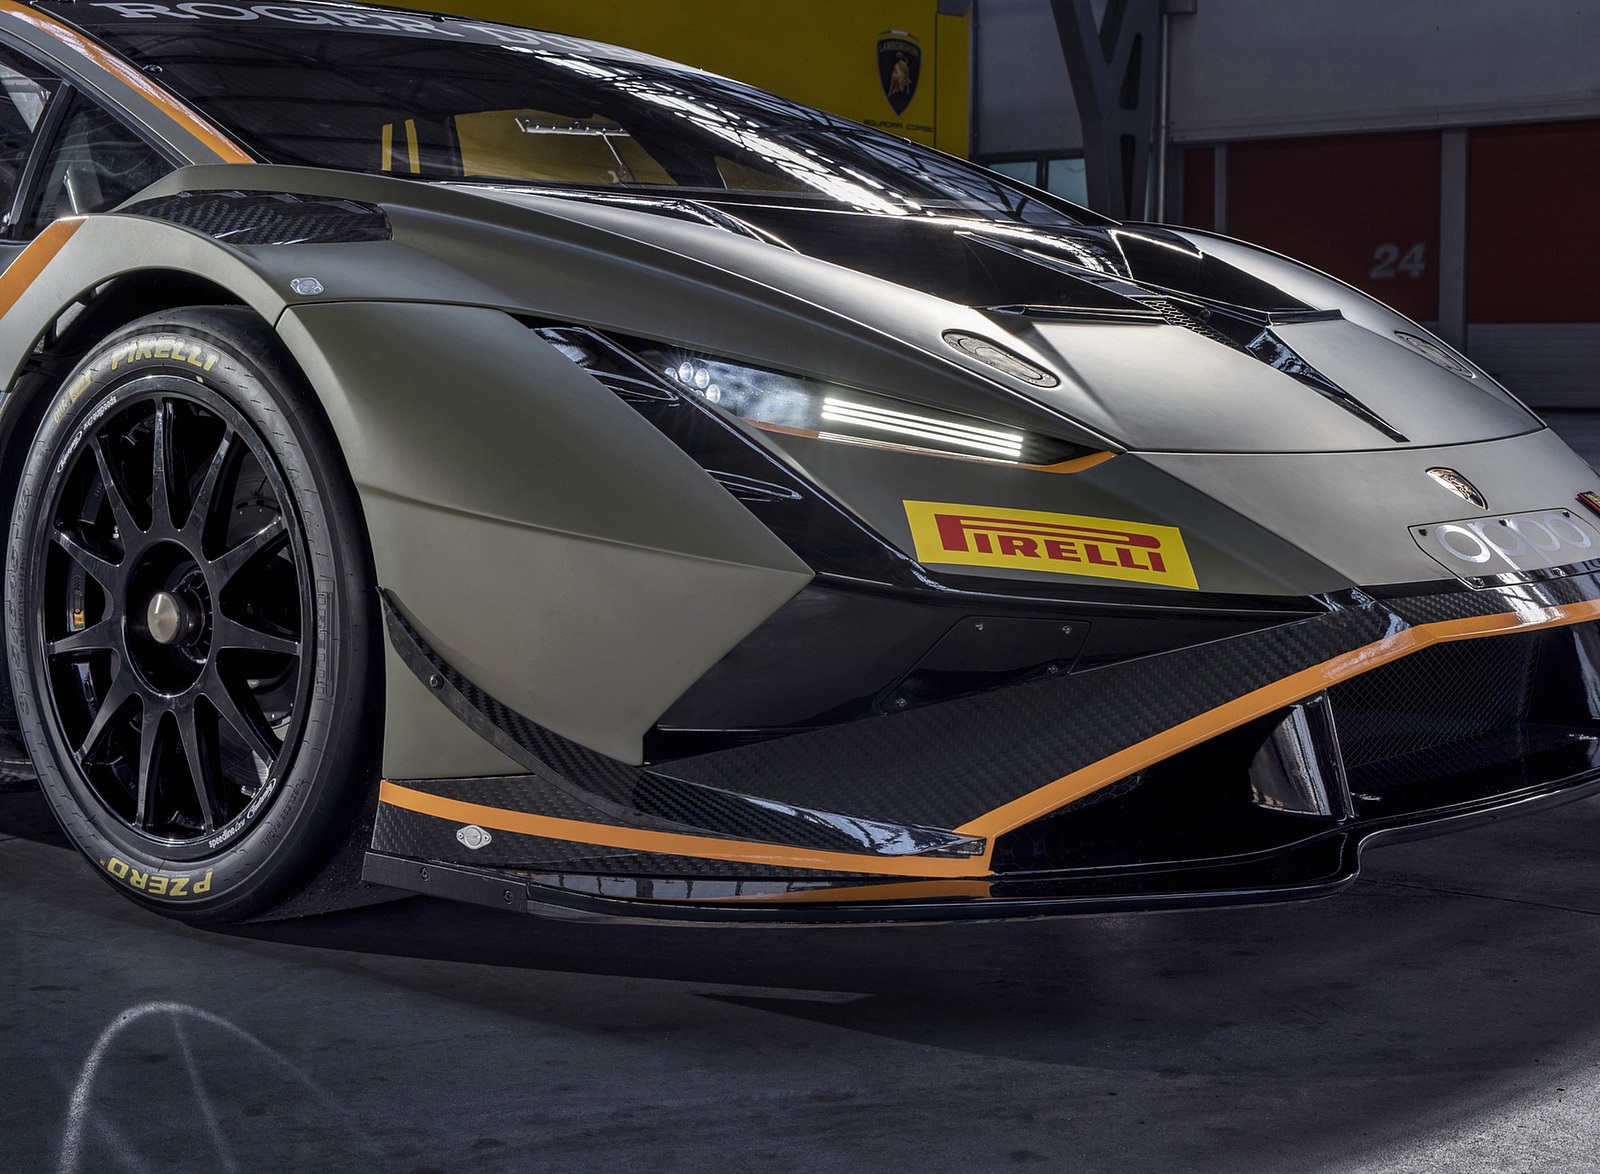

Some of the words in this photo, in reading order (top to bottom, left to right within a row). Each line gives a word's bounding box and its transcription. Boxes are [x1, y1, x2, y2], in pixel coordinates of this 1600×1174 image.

[89, 2, 465, 38] ROGER
[1370, 241, 1426, 279] 24
[112, 338, 218, 371] PIRELLI
[934, 513, 1166, 573] PIRELLI
[1436, 513, 1592, 571] oppo
[316, 579, 336, 698] PIRELLI
[280, 778, 308, 821] TUBELESS
[260, 818, 281, 846] RADIAL
